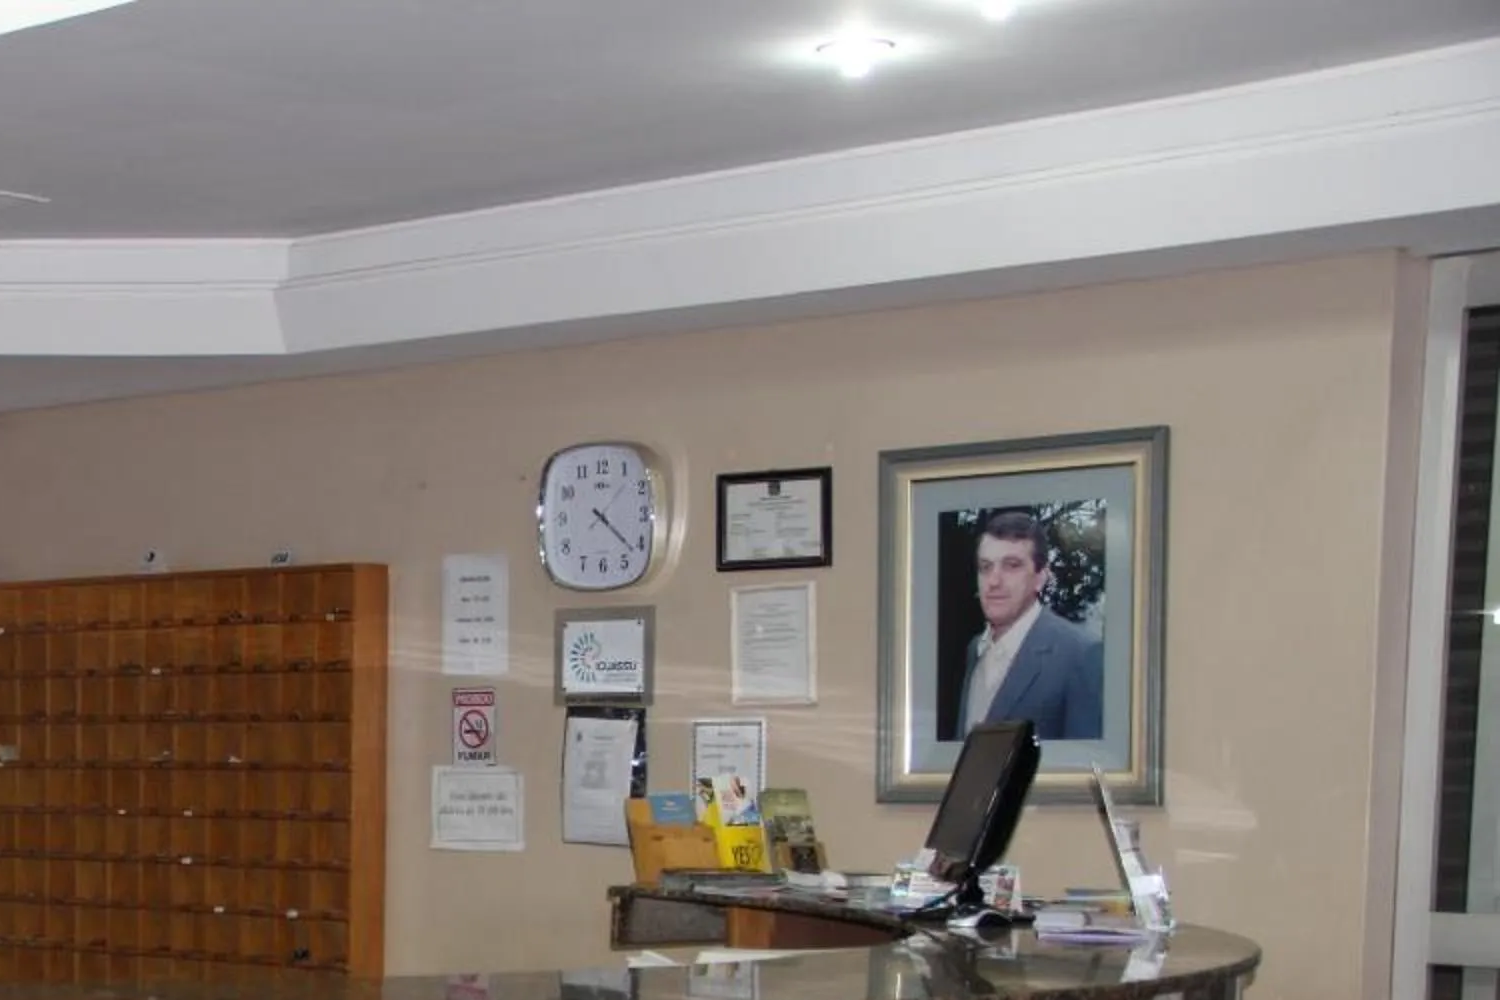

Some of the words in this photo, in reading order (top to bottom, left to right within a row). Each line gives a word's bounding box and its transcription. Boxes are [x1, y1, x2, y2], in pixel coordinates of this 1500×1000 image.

[577, 465, 588, 479] 11
[596, 460, 609, 475] 12
[622, 462, 627, 477] 1
[561, 485, 575, 500] 10
[637, 480, 645, 495] 2
[558, 511, 568, 527] 9
[639, 506, 649, 523] 3
[561, 538, 571, 555] 8
[636, 534, 645, 552] 4
[580, 555, 588, 573] 7
[598, 557, 608, 573] 6
[620, 554, 629, 570] 5
